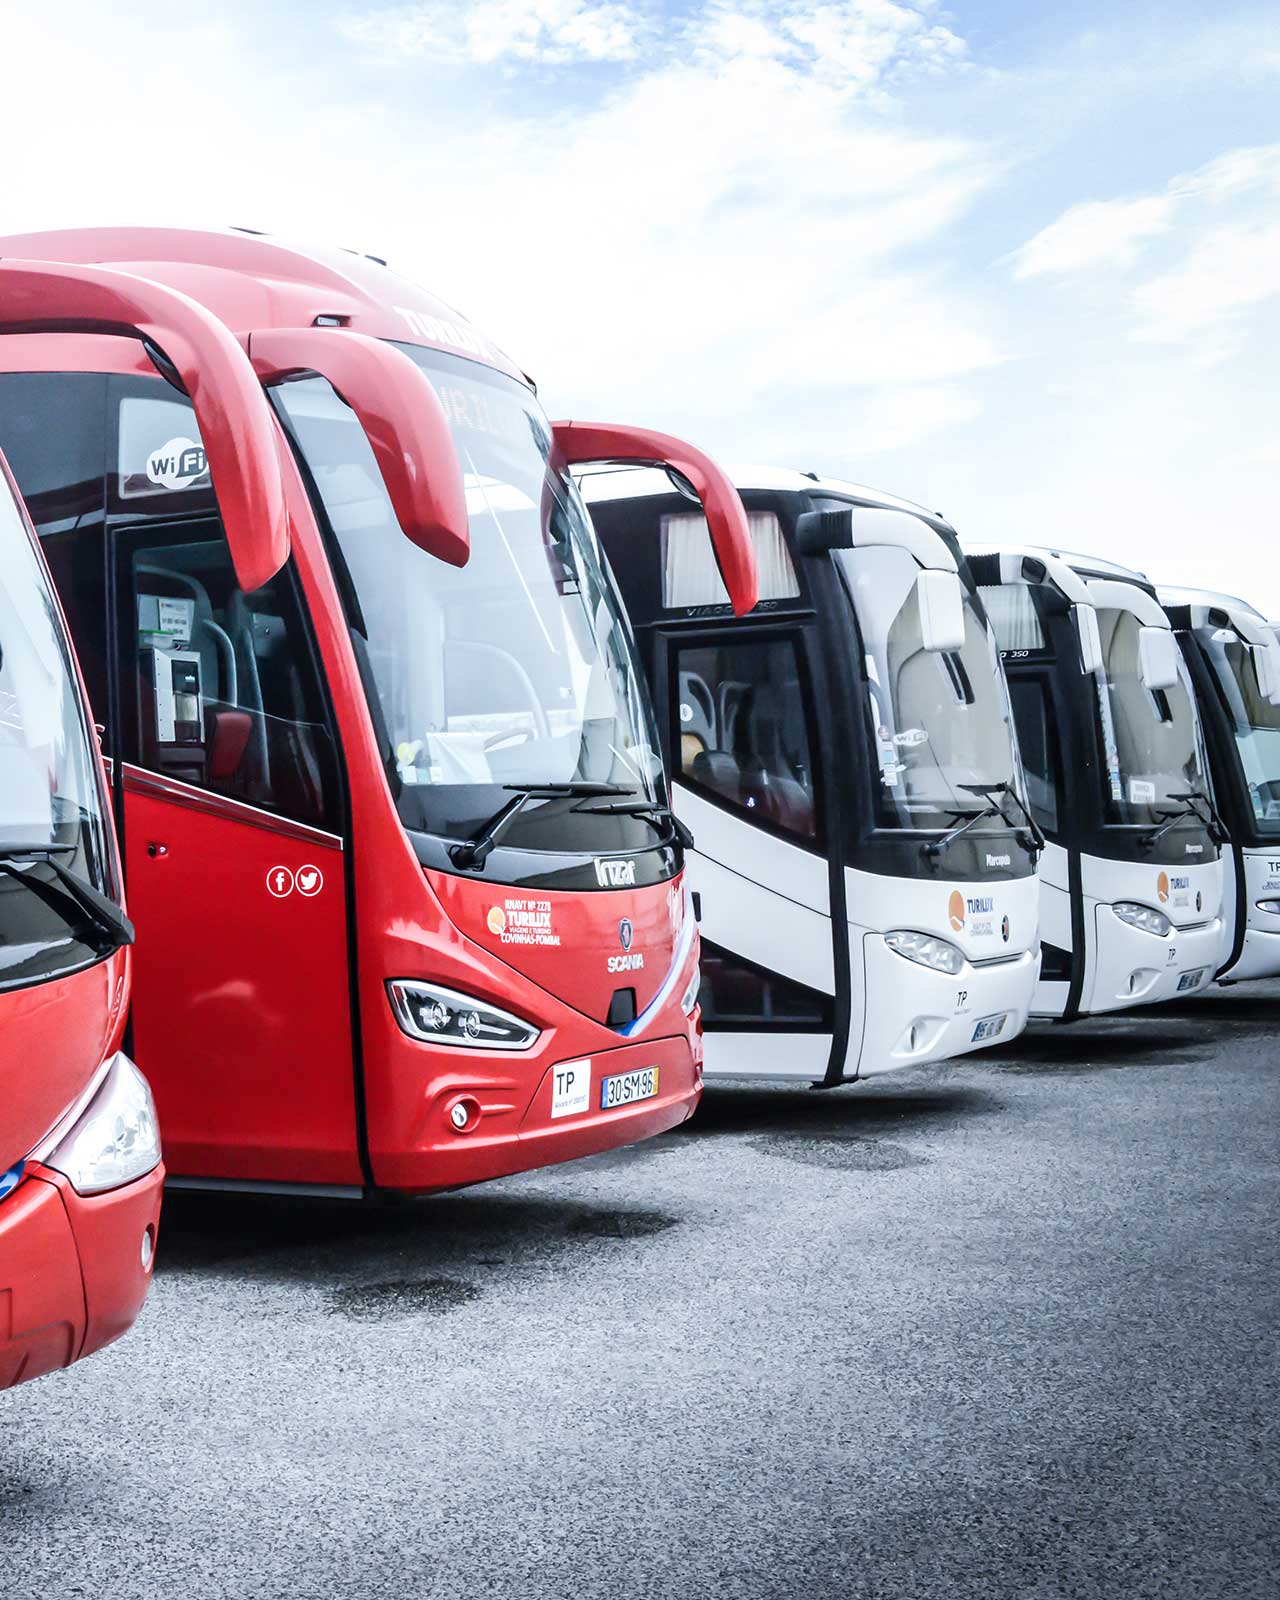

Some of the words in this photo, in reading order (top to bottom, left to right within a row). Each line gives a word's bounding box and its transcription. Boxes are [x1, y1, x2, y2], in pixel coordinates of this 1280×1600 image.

[536, 901, 552, 911] 2278
[506, 911, 552, 928] TURILUX
[501, 933, 561, 946] COVINHAS-POMBAL
[607, 954, 645, 974] SCANIA
[957, 991, 968, 1007] TP
[556, 1071, 575, 1095] TP
